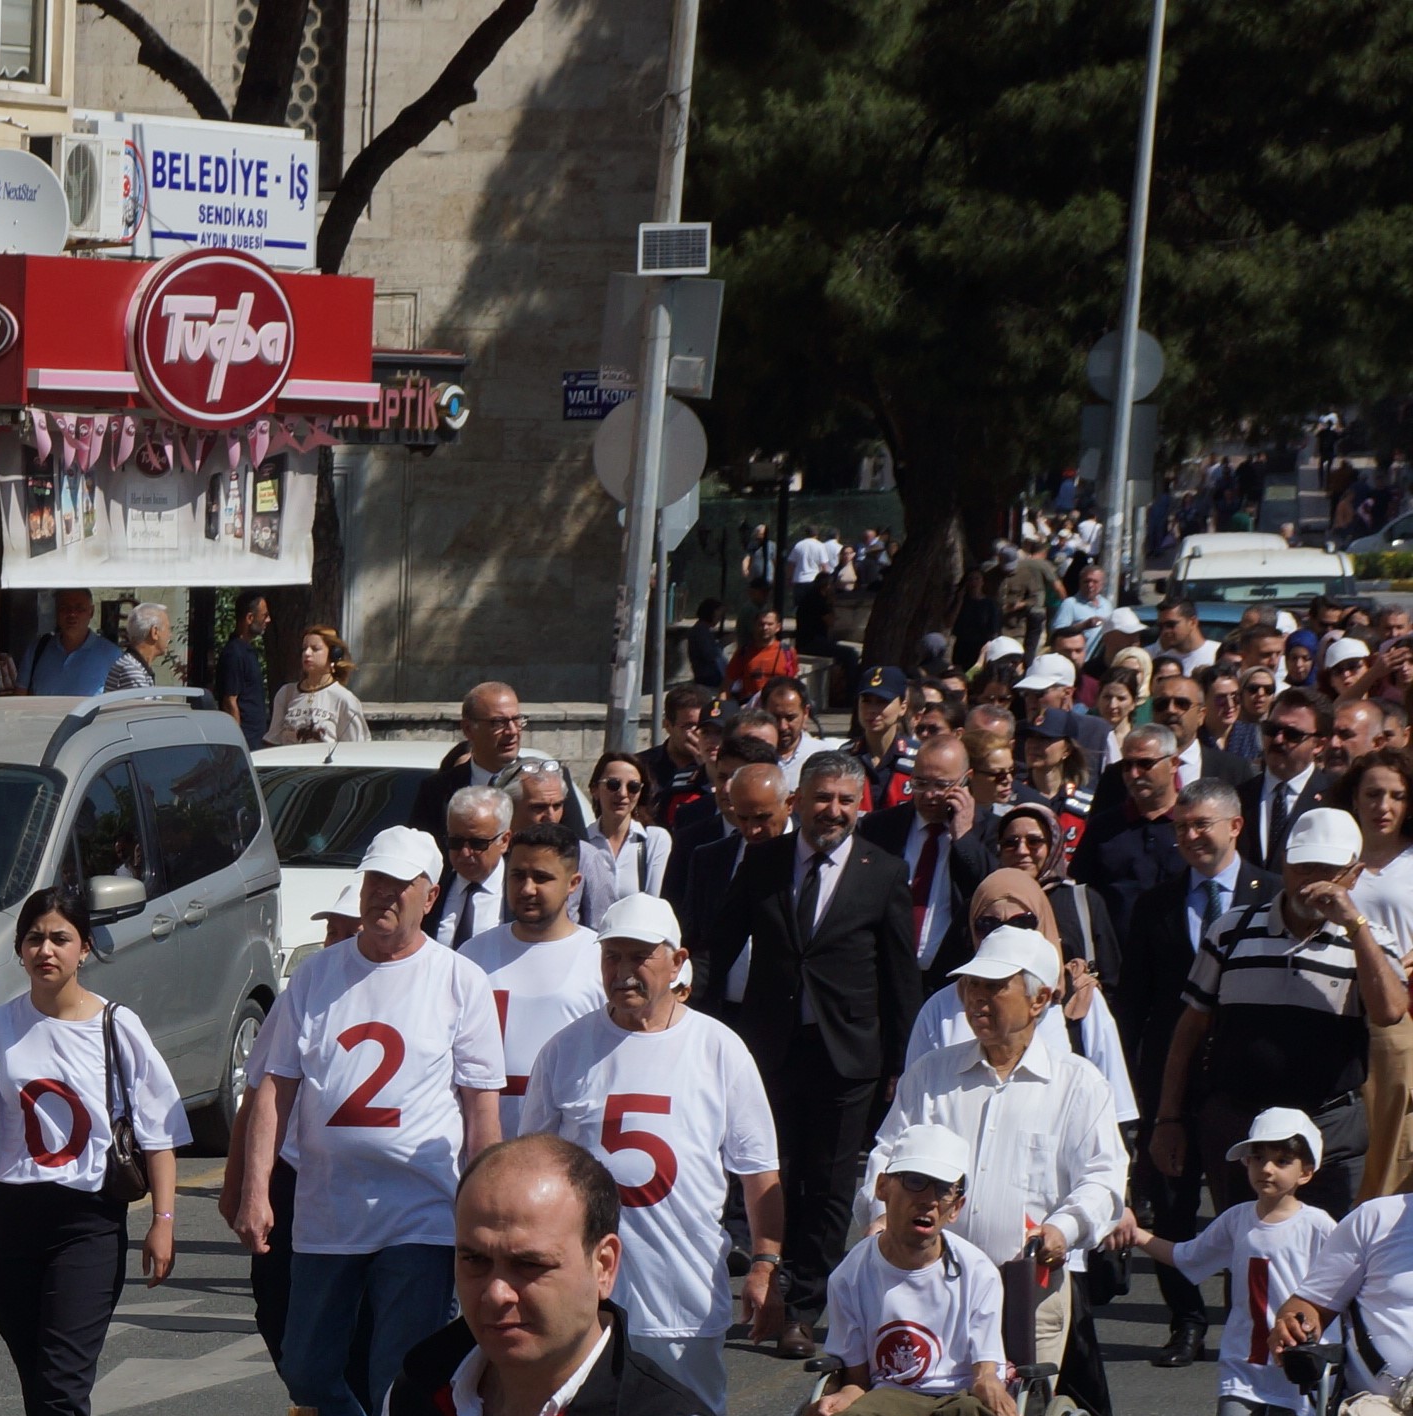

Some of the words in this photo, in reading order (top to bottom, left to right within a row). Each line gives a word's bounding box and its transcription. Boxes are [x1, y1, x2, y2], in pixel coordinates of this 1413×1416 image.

[152, 148, 268, 198] BELEDİYE
[289, 154, 308, 210] İŞ
[198, 203, 267, 229] SENDİKASI
[200, 232, 229, 248] AYDIN
[327, 1020, 401, 1128] 2
[600, 1093, 678, 1208] 5
